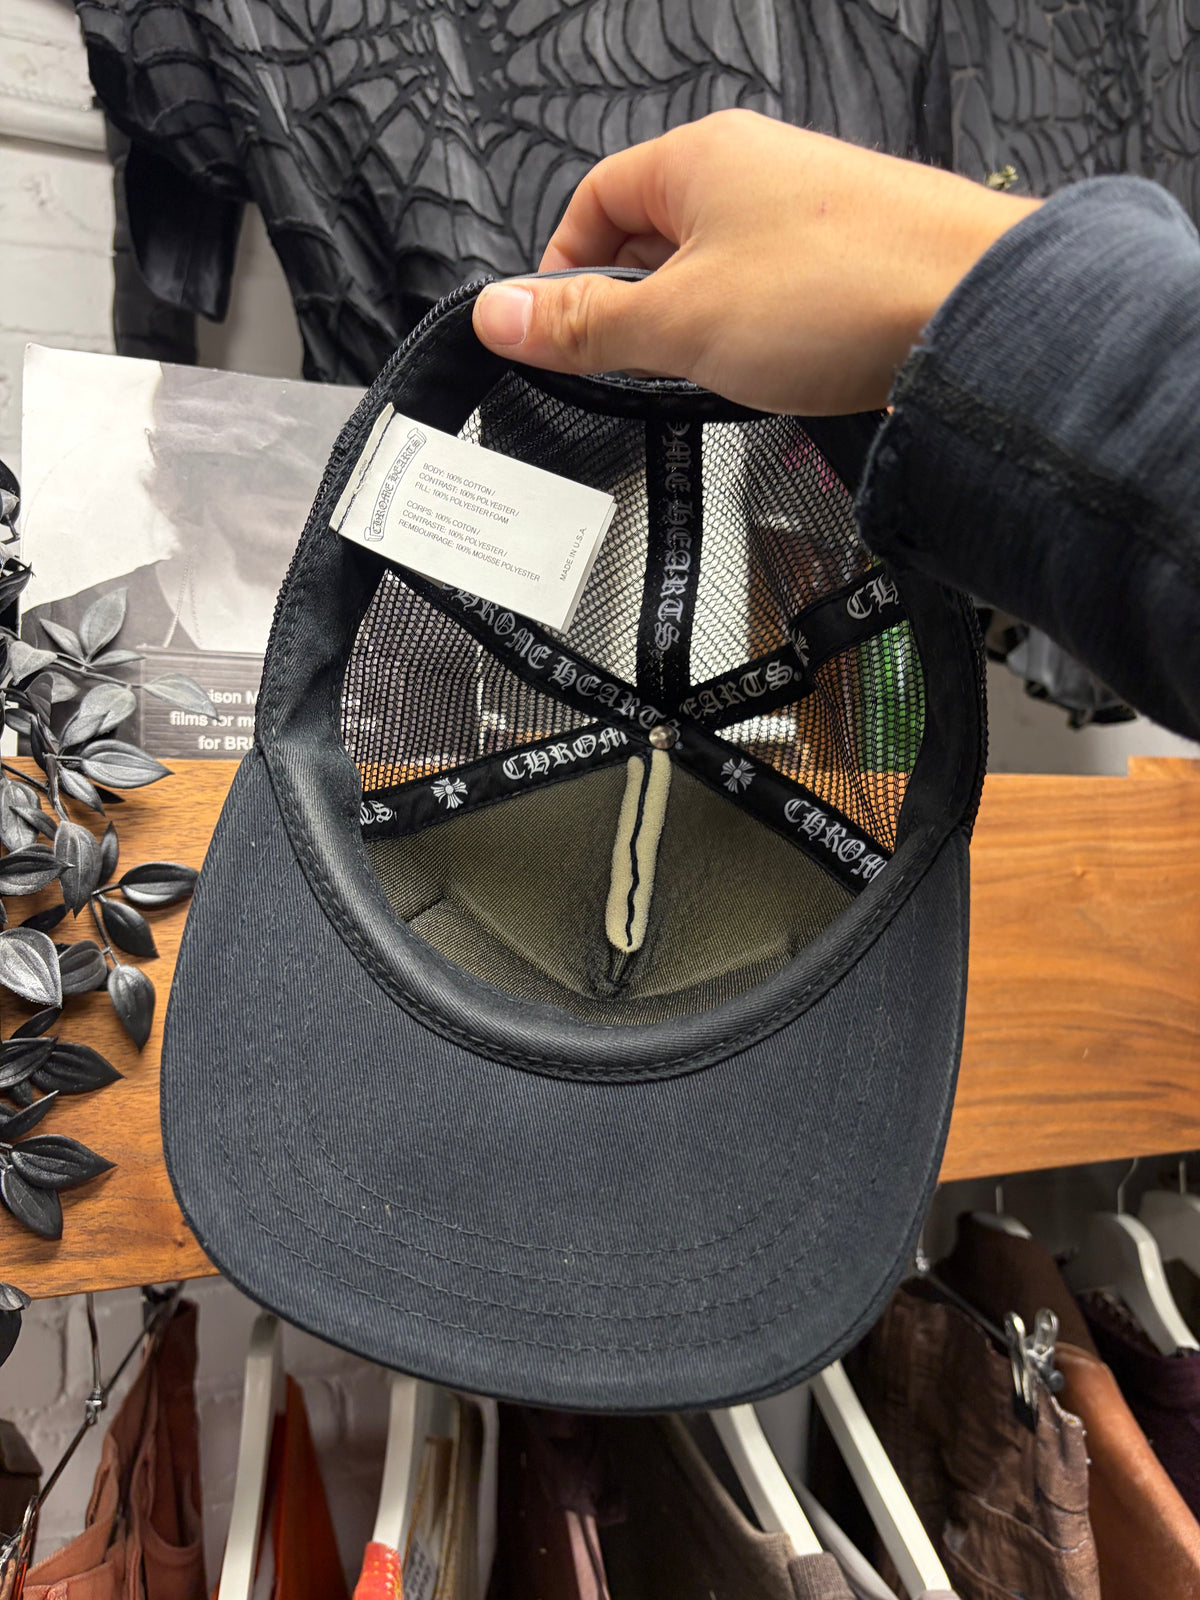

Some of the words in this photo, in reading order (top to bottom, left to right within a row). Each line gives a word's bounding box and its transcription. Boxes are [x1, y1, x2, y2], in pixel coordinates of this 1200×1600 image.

[372, 483, 394, 535] CHROME
[388, 439, 422, 483] HEARTS
[419, 472, 458, 494] CONTRAST:
[459, 488, 476, 501] 100%
[475, 495, 516, 516] POLYESTER
[422, 462, 445, 478] BODY:
[446, 472, 463, 485] 100%
[463, 479, 492, 496] COTTON
[406, 500, 434, 516] CORPS:
[435, 512, 451, 525] 100%
[452, 519, 477, 535] COTON
[414, 481, 431, 494] FILL:
[432, 489, 449, 502] 100%
[449, 496, 489, 516] POLYESTER
[488, 511, 510, 525] FOAM
[398, 518, 455, 548] REMBOURRAGE:
[455, 543, 472, 556] 100%
[472, 549, 502, 567] MOUSSE
[501, 561, 541, 582] POLYESTER
[402, 509, 446, 533] CONTRASTE:
[448, 529, 464, 541] 100%
[464, 535, 504, 557] POLYESTER
[559, 558, 574, 581] MADE
[569, 549, 577, 558] IN
[654, 500, 694, 651] HEARTS
[443, 584, 553, 669] HROME
[169, 711, 209, 727] films
[198, 735, 222, 750] for
